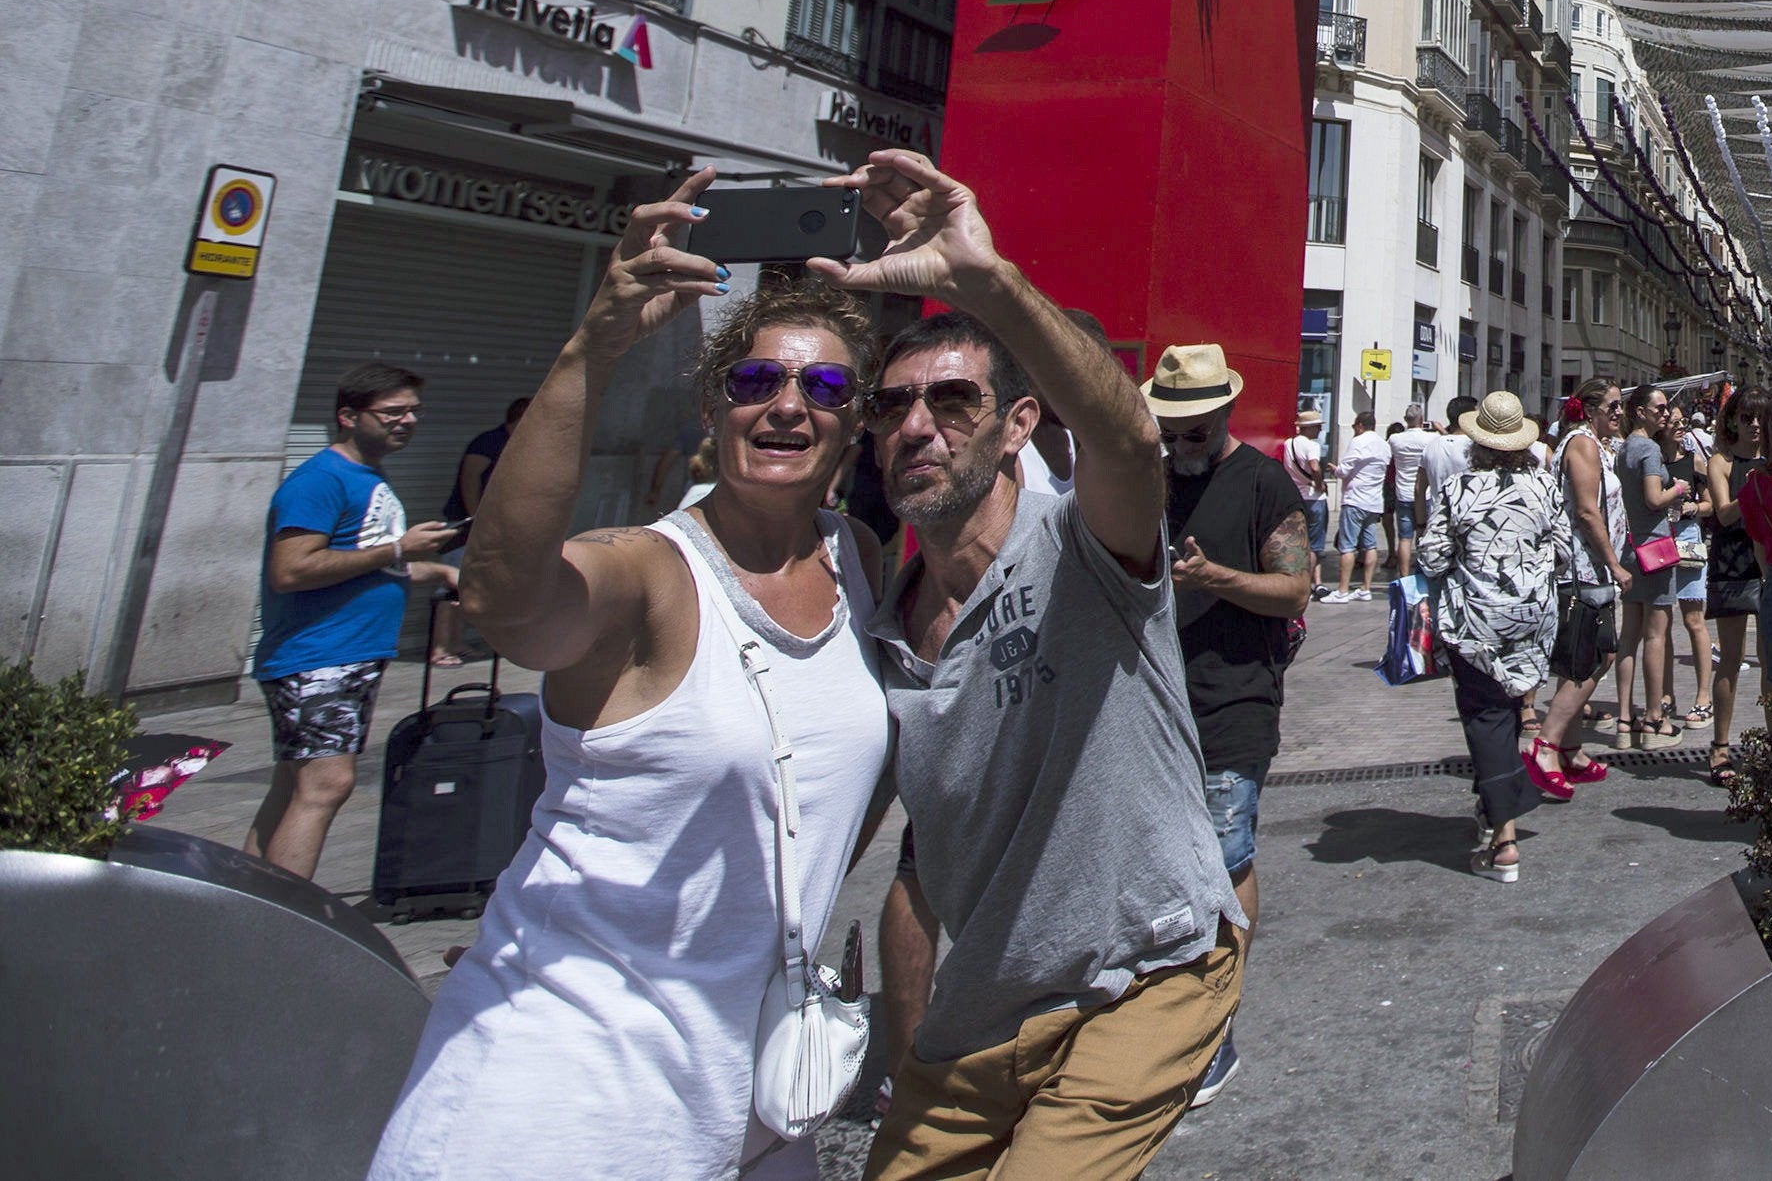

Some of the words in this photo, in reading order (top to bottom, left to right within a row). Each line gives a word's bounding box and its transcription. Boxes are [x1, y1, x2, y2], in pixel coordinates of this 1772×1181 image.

[829, 91, 913, 143] helvetia
[199, 252, 253, 267] HIDRANTE
[1419, 324, 1434, 343] BBVA
[1000, 634, 1029, 663] J&J
[994, 657, 1057, 709] 1975
